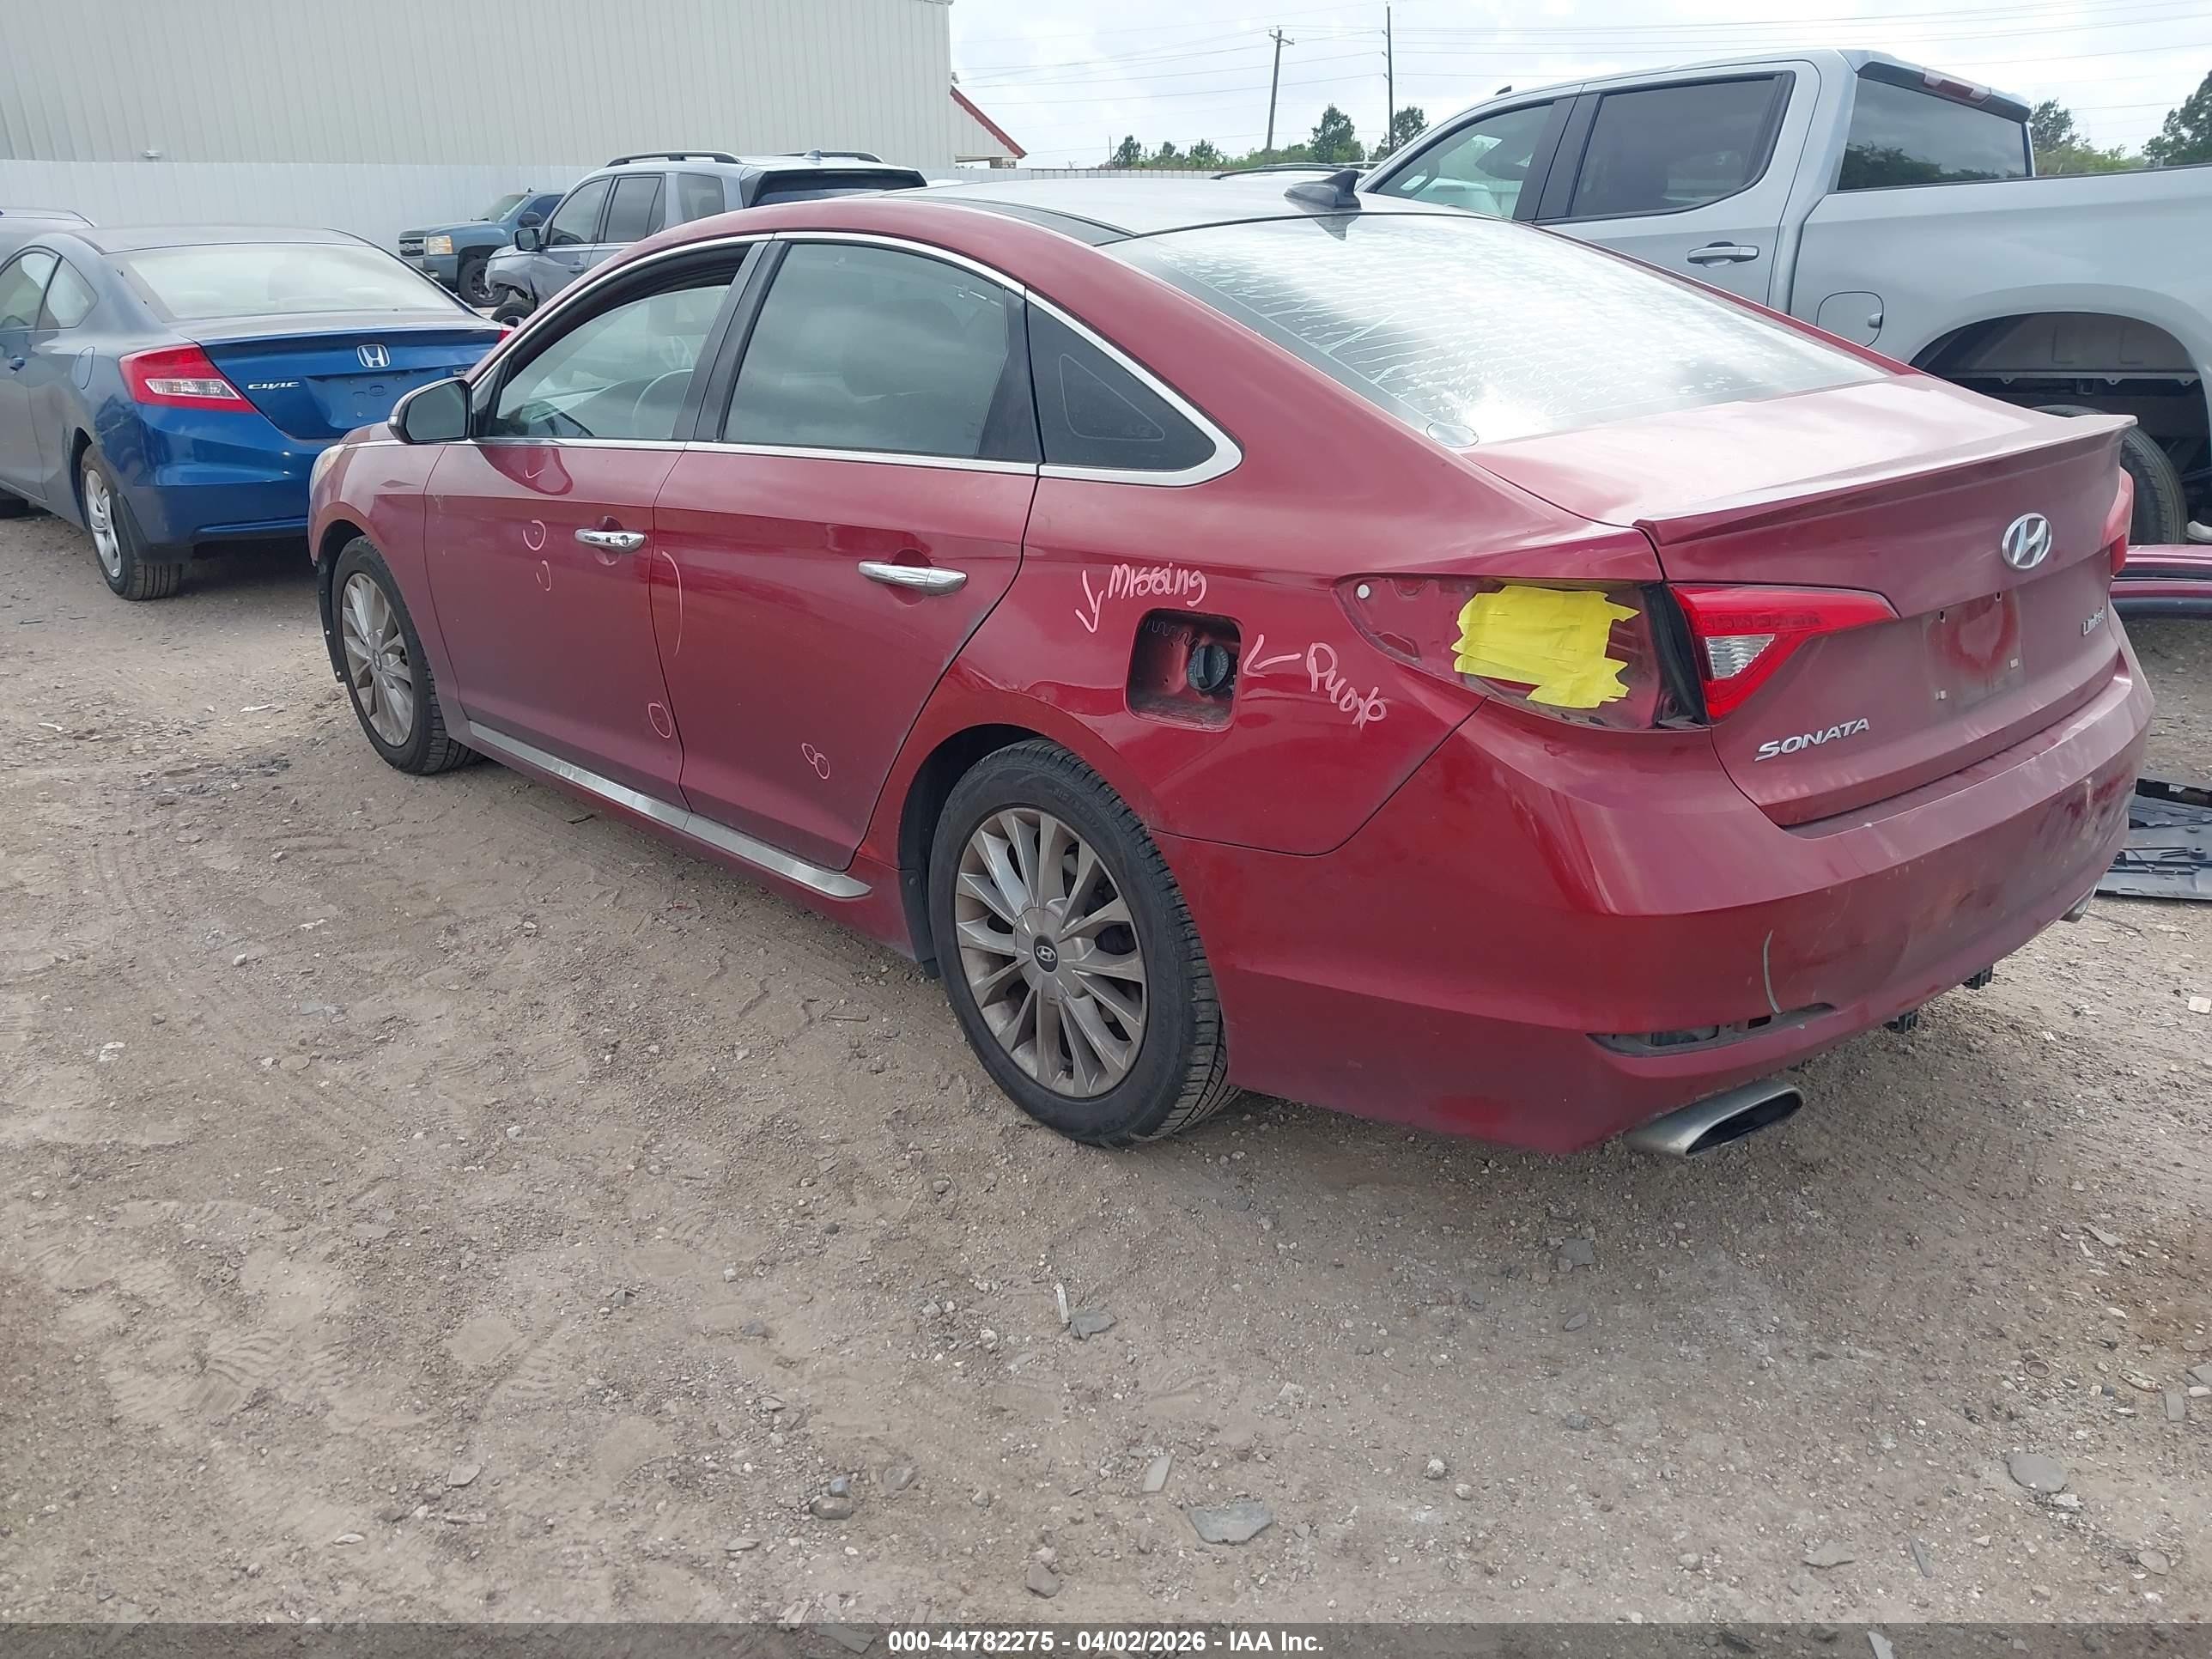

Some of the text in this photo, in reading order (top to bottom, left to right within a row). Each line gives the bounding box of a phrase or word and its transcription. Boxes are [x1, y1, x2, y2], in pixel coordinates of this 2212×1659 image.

[247, 381, 301, 390] CIVIC
[1108, 562, 1207, 607] Missing
[1754, 717, 1870, 762] SONATA
